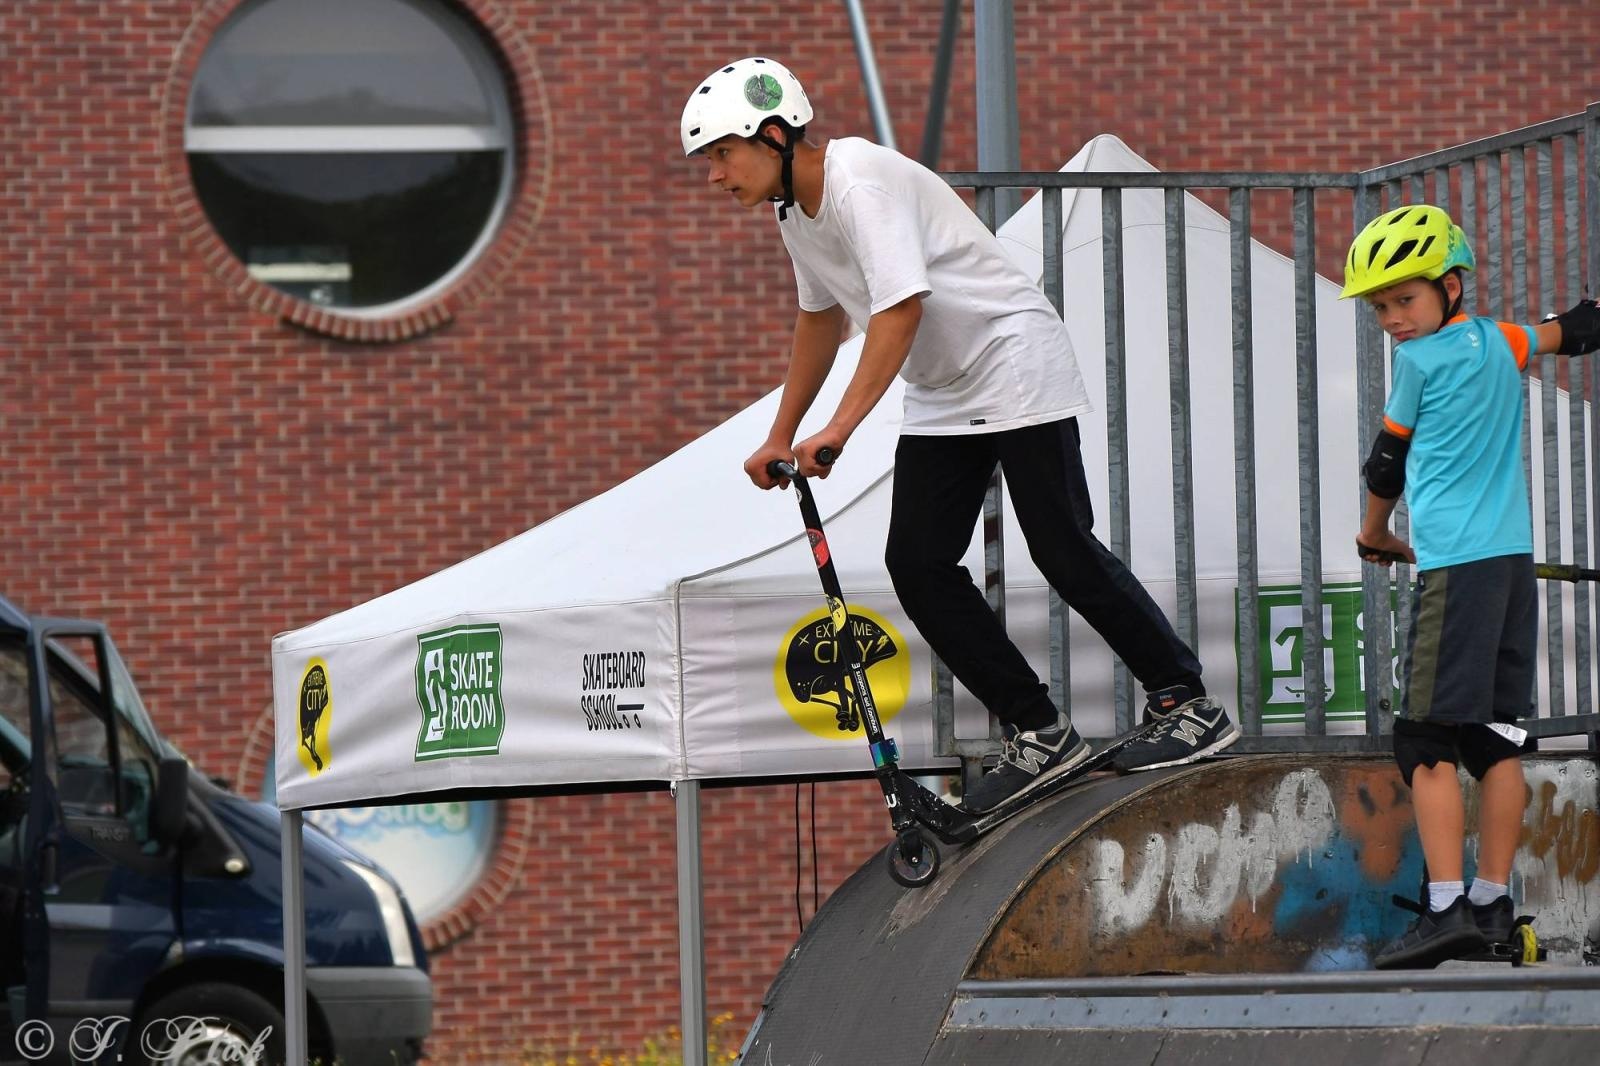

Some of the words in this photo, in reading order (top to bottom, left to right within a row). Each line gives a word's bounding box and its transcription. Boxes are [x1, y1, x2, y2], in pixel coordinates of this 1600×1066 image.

[815, 621, 872, 638] EXTME
[814, 640, 874, 664] CIY
[450, 651, 494, 691] SKATE
[582, 651, 646, 691] SKATEBOARD
[306, 688, 323, 711] CITY
[451, 693, 497, 730] ROOM
[581, 693, 624, 732] SCHOOL
